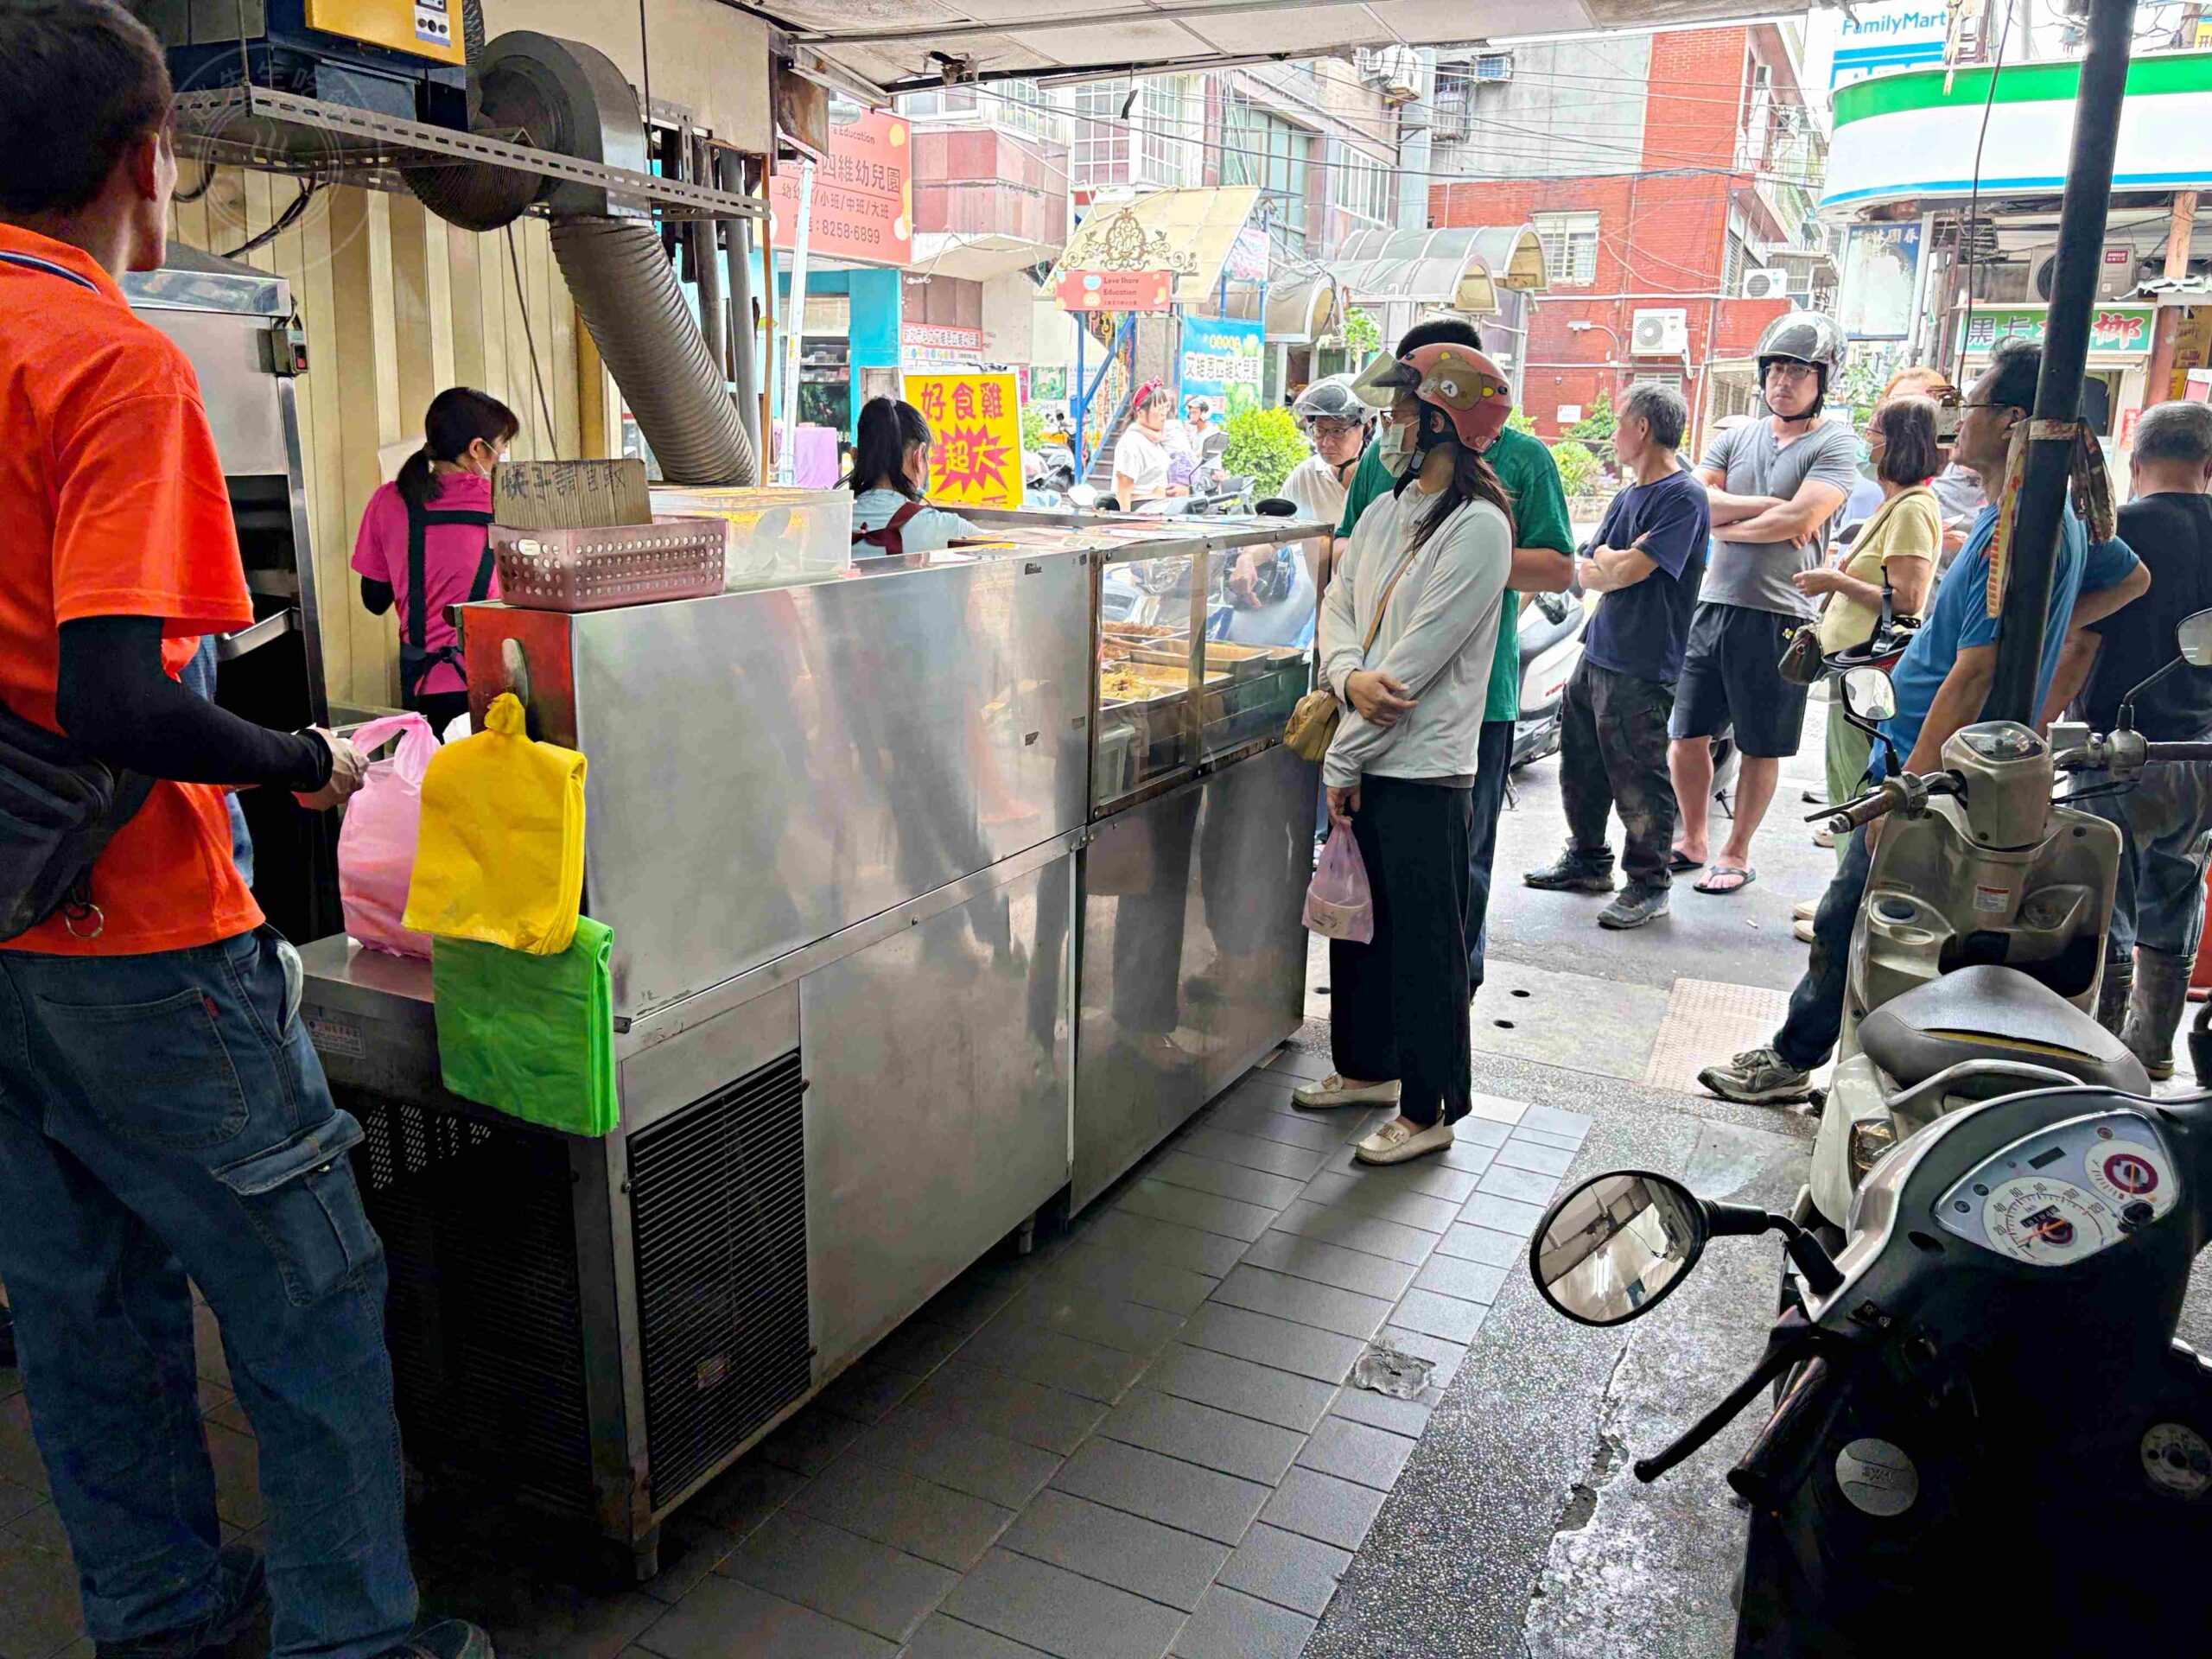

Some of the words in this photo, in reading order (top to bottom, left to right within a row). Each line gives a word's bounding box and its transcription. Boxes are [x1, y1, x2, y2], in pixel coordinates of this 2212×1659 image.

[1842, 11, 1947, 35] FamilyMart
[840, 126, 875, 145] Education
[1967, 311, 2145, 350] 黑卡榔
[921, 381, 1003, 422] 好食雞
[944, 438, 997, 474] 超大
[1993, 1202, 2006, 1213] 40
[2088, 1202, 2105, 1214] 120
[1993, 1224, 2006, 1236] 20
